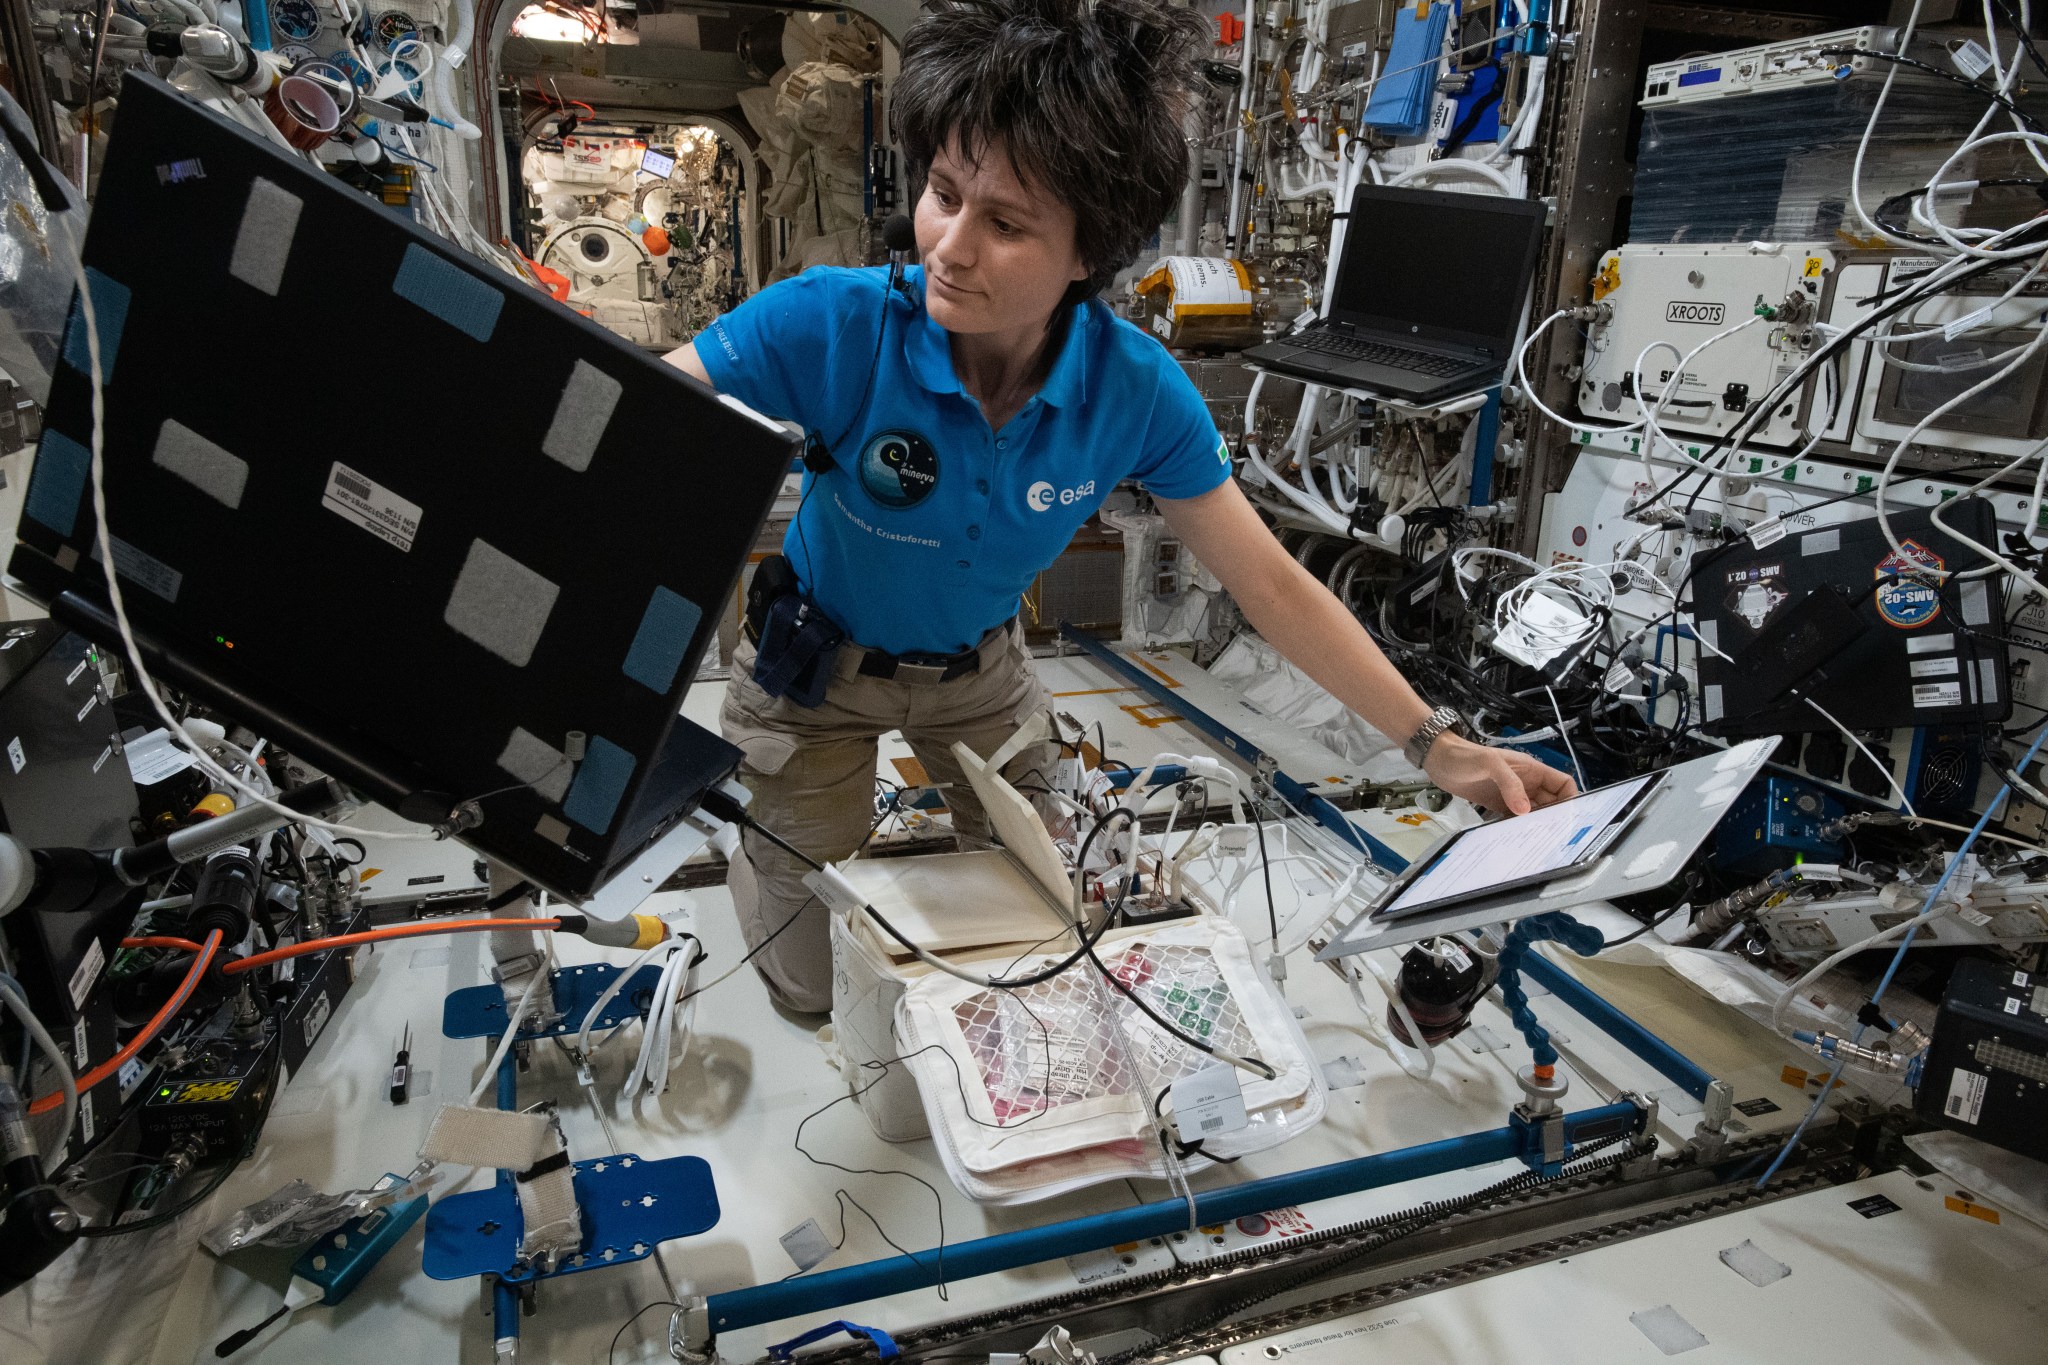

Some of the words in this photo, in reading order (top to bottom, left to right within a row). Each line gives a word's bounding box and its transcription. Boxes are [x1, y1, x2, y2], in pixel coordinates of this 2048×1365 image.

[395, 21, 413, 31] futura
[390, 127, 421, 138] aha
[1195, 262, 1207, 288] items.
[1669, 304, 1722, 322] XROOTS
[899, 466, 935, 484] minerva
[1059, 480, 1095, 505] esa
[385, 507, 402, 521] 1136
[404, 517, 417, 529] S/N
[834, 492, 872, 533] Samantha
[876, 527, 941, 549] Cristoforetti
[365, 521, 391, 539] Laptop
[400, 525, 414, 537] P/N
[392, 536, 409, 551] T61p
[1622, 564, 1645, 576] SMOKE
[1760, 565, 1780, 577] AMS
[1728, 571, 1747, 583] 02.1
[1884, 589, 1935, 604] AMS-02
[2027, 607, 2046, 619] J10
[2021, 616, 2046, 628] RS232
[228, 1064, 239, 1076] OFF
[1204, 1094, 1215, 1102] Cable
[170, 1122, 191, 1130] MAX
[196, 1119, 225, 1127] INPUT
[1281, 1213, 1297, 1228] PORT
[1369, 1322, 1384, 1332] 5/32
[1384, 1318, 1399, 1328] Use
[1344, 1328, 1354, 1336] for
[1354, 1325, 1369, 1334] hex
[1322, 1331, 1344, 1342] these
[1288, 1336, 1323, 1350] fasteners
